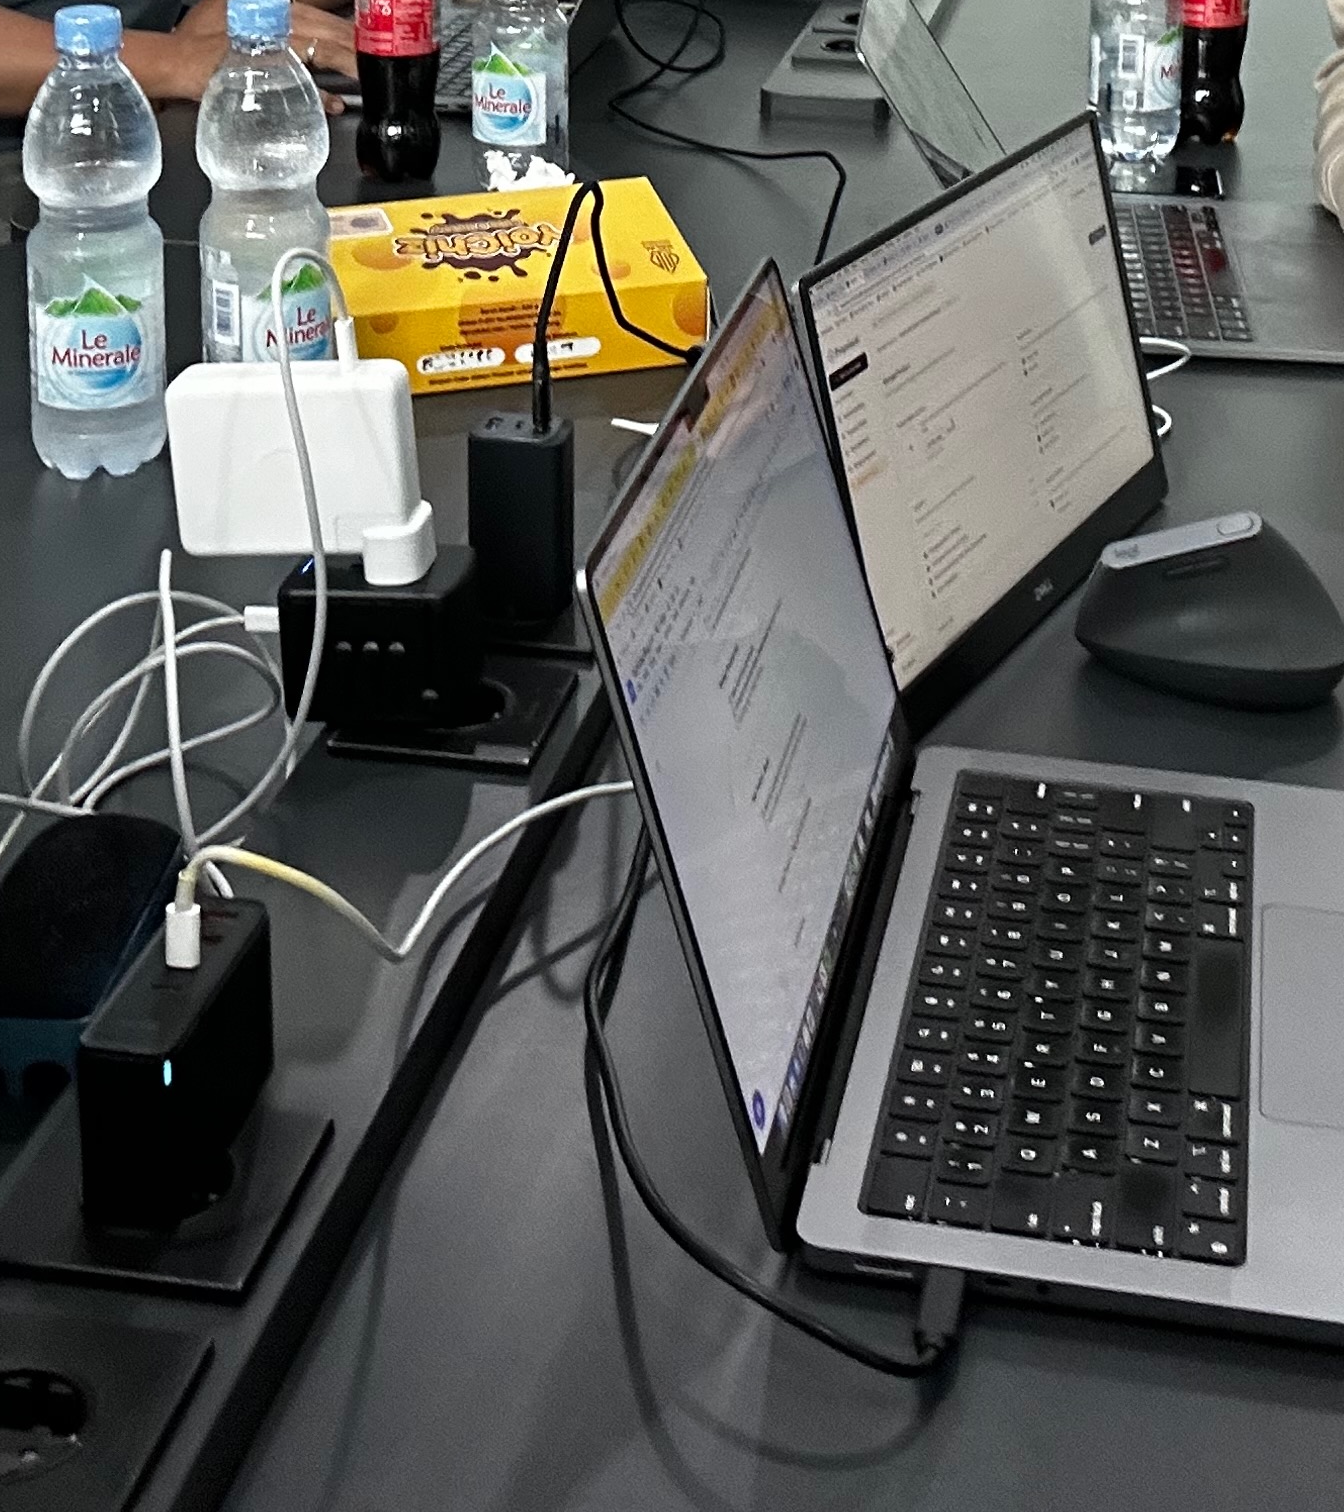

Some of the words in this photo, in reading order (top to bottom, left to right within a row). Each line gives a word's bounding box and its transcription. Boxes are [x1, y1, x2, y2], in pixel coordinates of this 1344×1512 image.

[489, 82, 506, 99] Le
[474, 93, 532, 114] Minerale
[297, 306, 316, 326] Le
[81, 329, 108, 350] Le
[52, 344, 141, 368] Minerale
